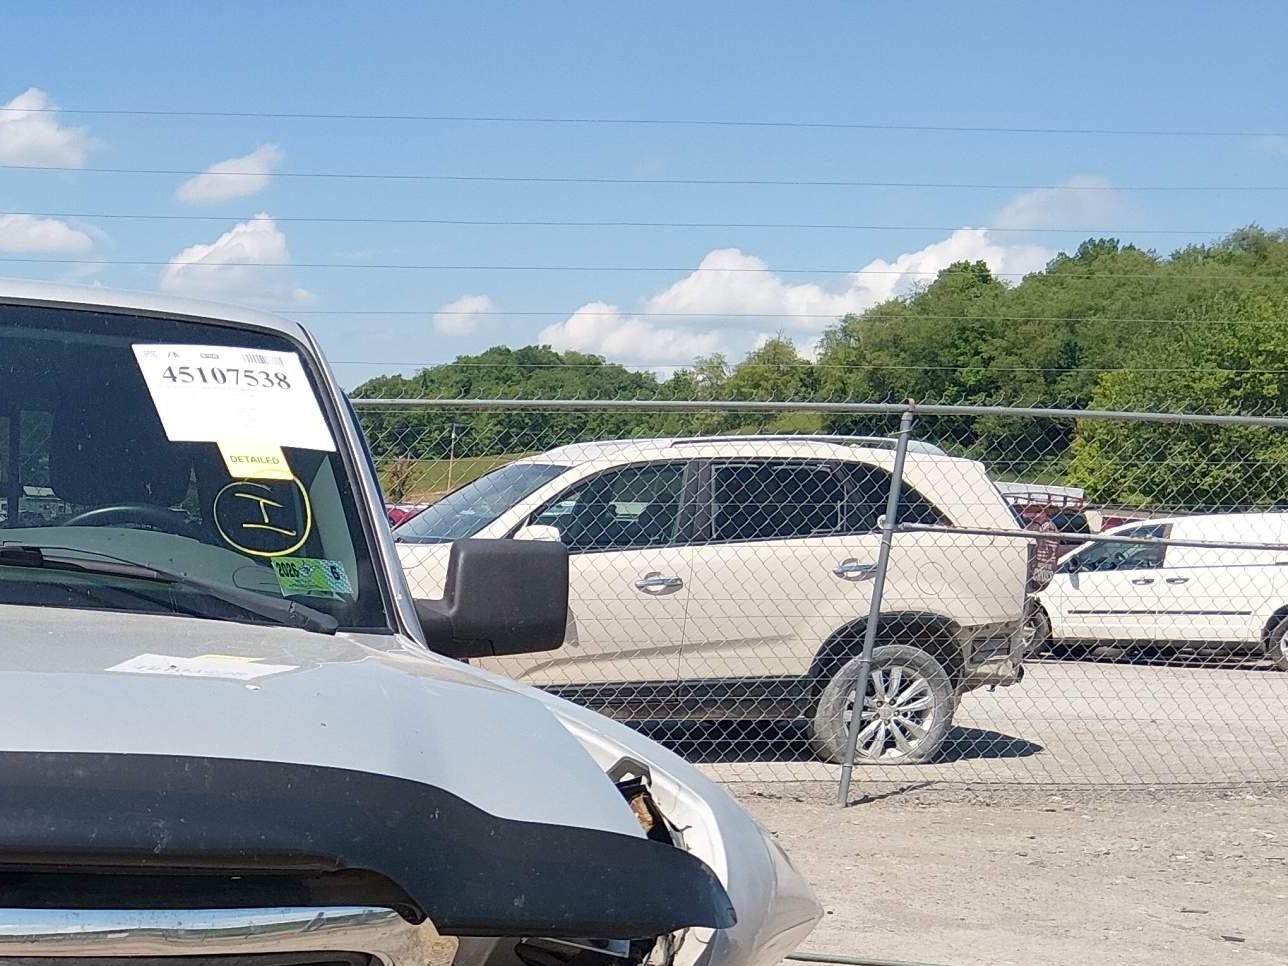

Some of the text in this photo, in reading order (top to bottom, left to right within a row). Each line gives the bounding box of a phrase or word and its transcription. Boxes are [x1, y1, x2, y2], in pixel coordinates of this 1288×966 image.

[162, 365, 291, 390] 45107538
[229, 455, 280, 465] DETAILED
[274, 561, 300, 578] 2026
[329, 565, 341, 580] 6
